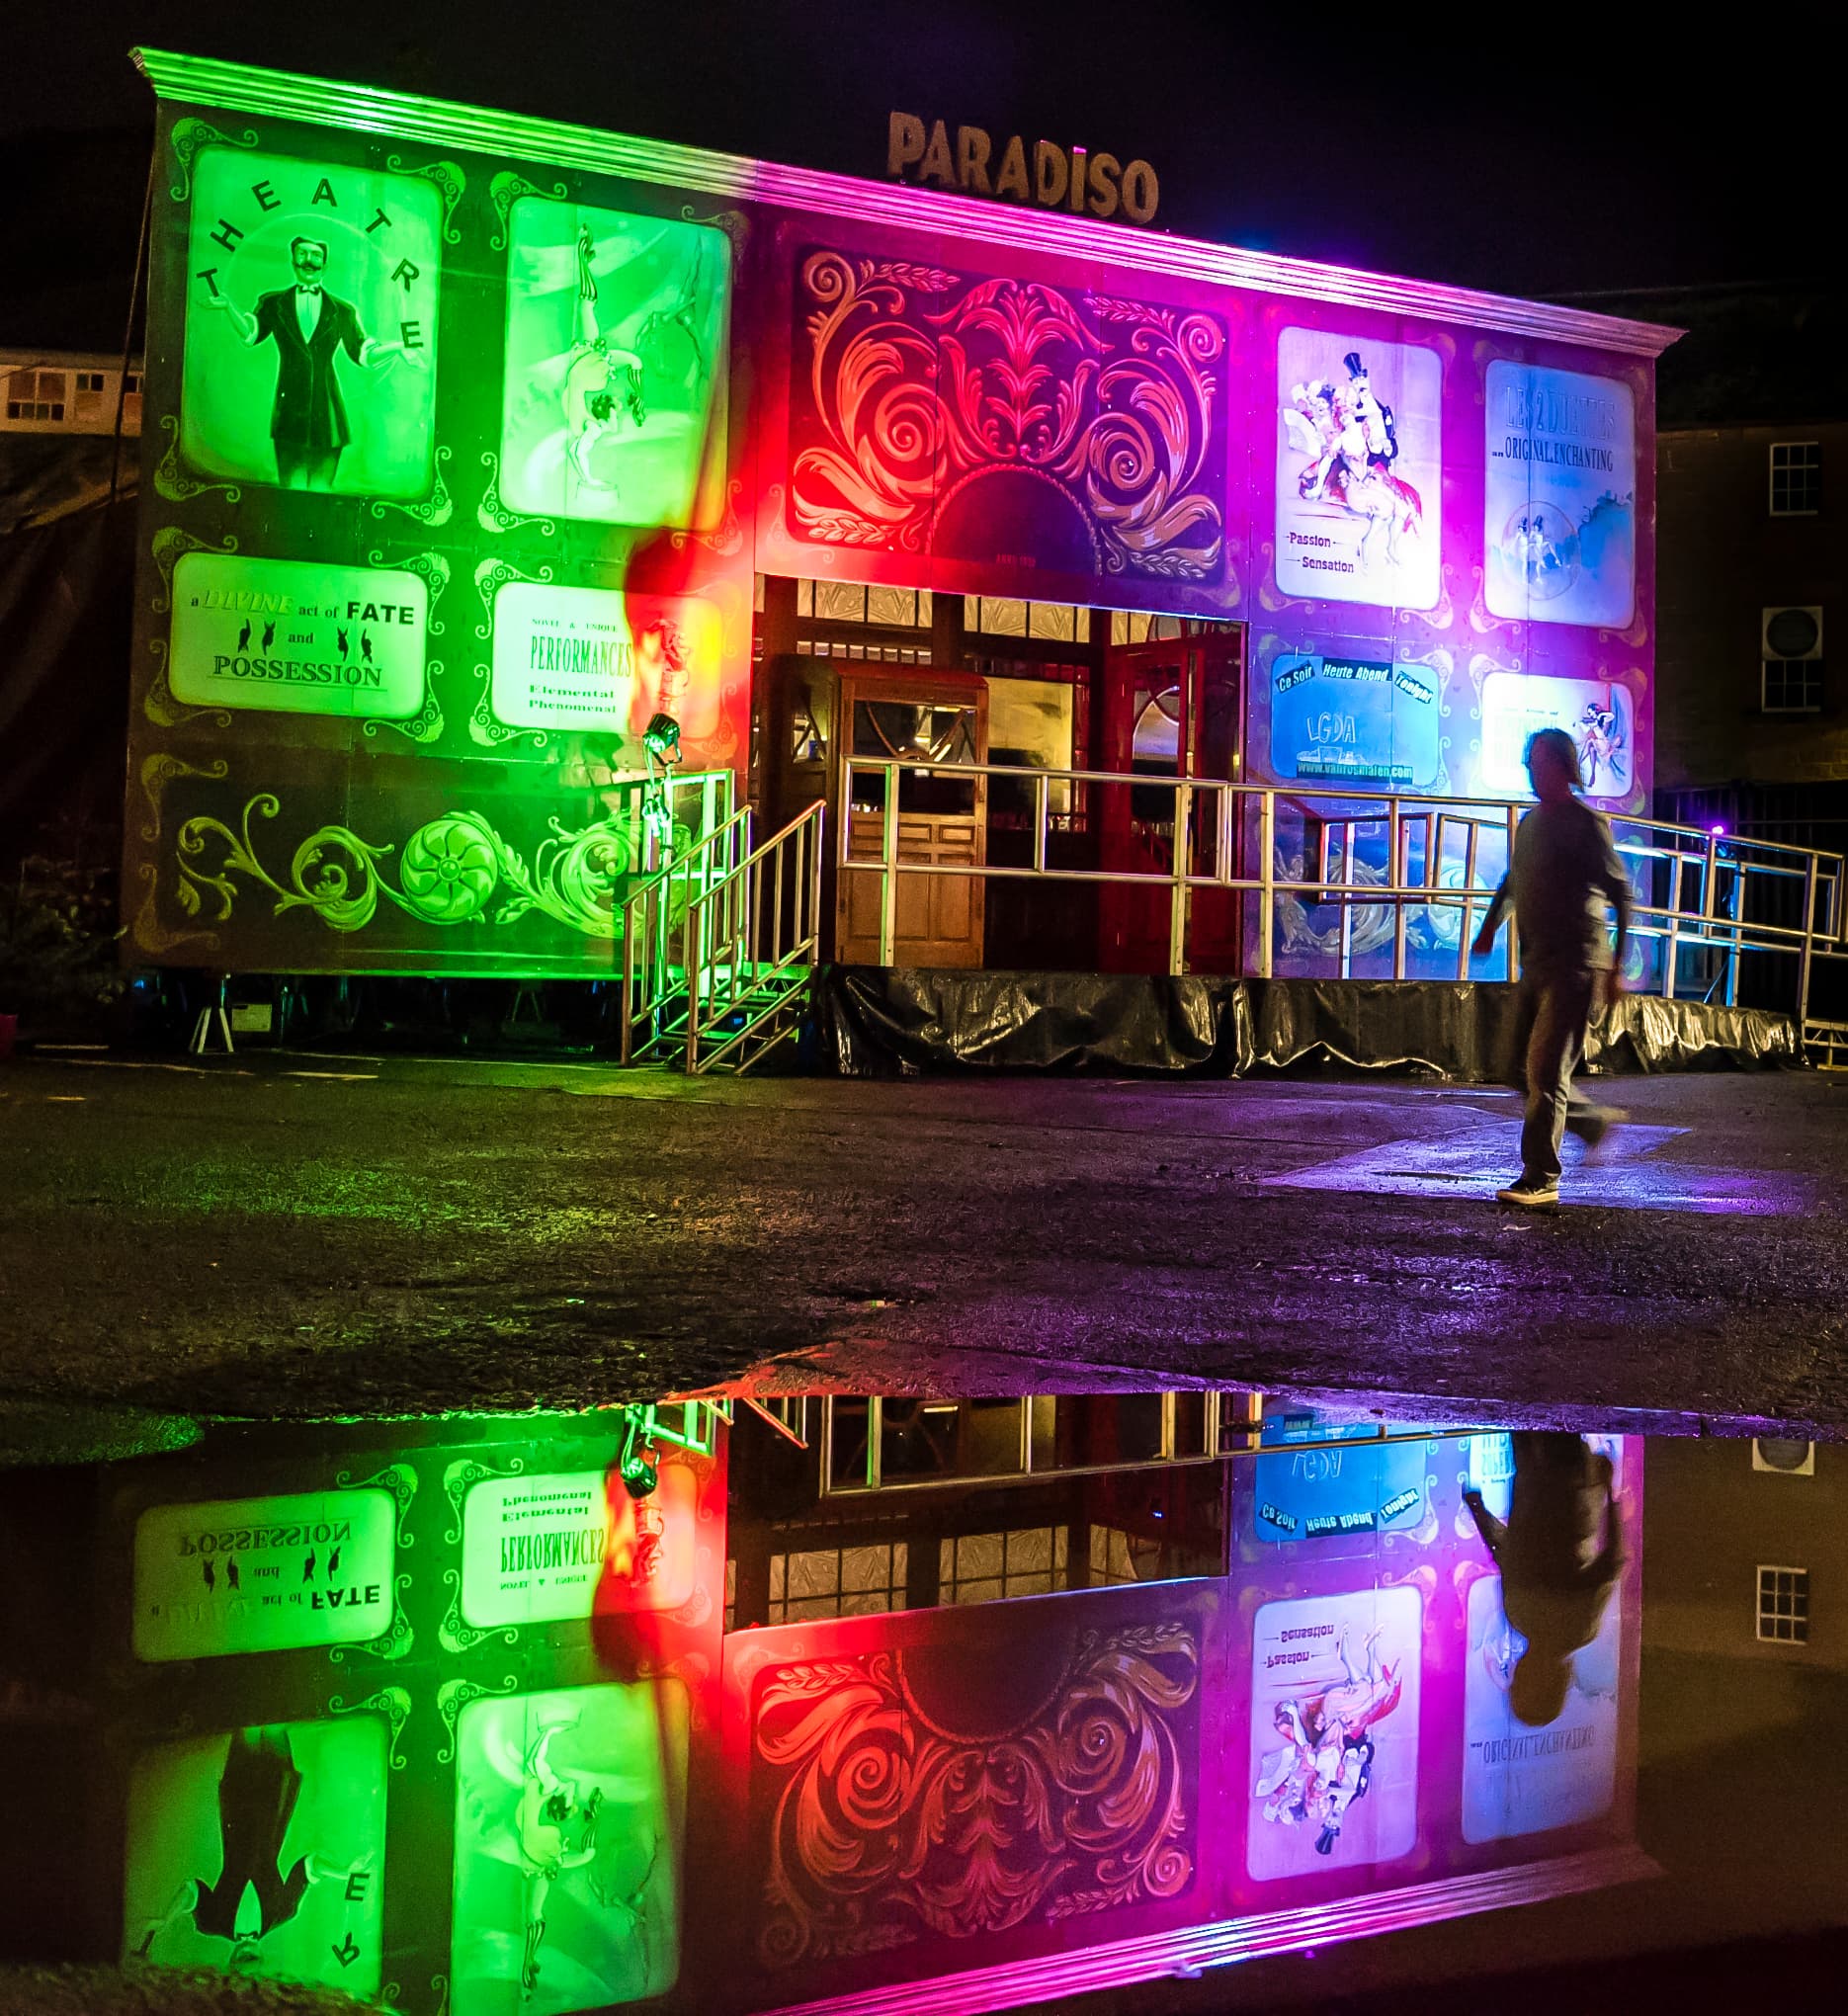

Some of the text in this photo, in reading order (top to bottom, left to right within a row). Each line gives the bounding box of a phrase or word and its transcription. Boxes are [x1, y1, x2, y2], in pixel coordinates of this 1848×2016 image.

[887, 111, 1159, 224] PARADISO
[197, 178, 424, 350] THEATRE
[1554, 442, 1614, 472] ENCHANTING
[1289, 532, 1331, 547] Passion
[1302, 555, 1355, 573] Sensation
[202, 589, 295, 616] DIVINE
[298, 605, 319, 617] act
[324, 606, 340, 619] of
[346, 601, 414, 625] FATE
[288, 631, 314, 643] and
[530, 634, 633, 678] PERFORMANCES
[212, 655, 382, 687] POSSESSION
[1322, 663, 1387, 682] Heute Abend
[529, 684, 615, 699] Elemental
[1279, 676, 1293, 692] Ce
[1394, 673, 1434, 704] Tonight
[529, 699, 617, 714] Phenomenal
